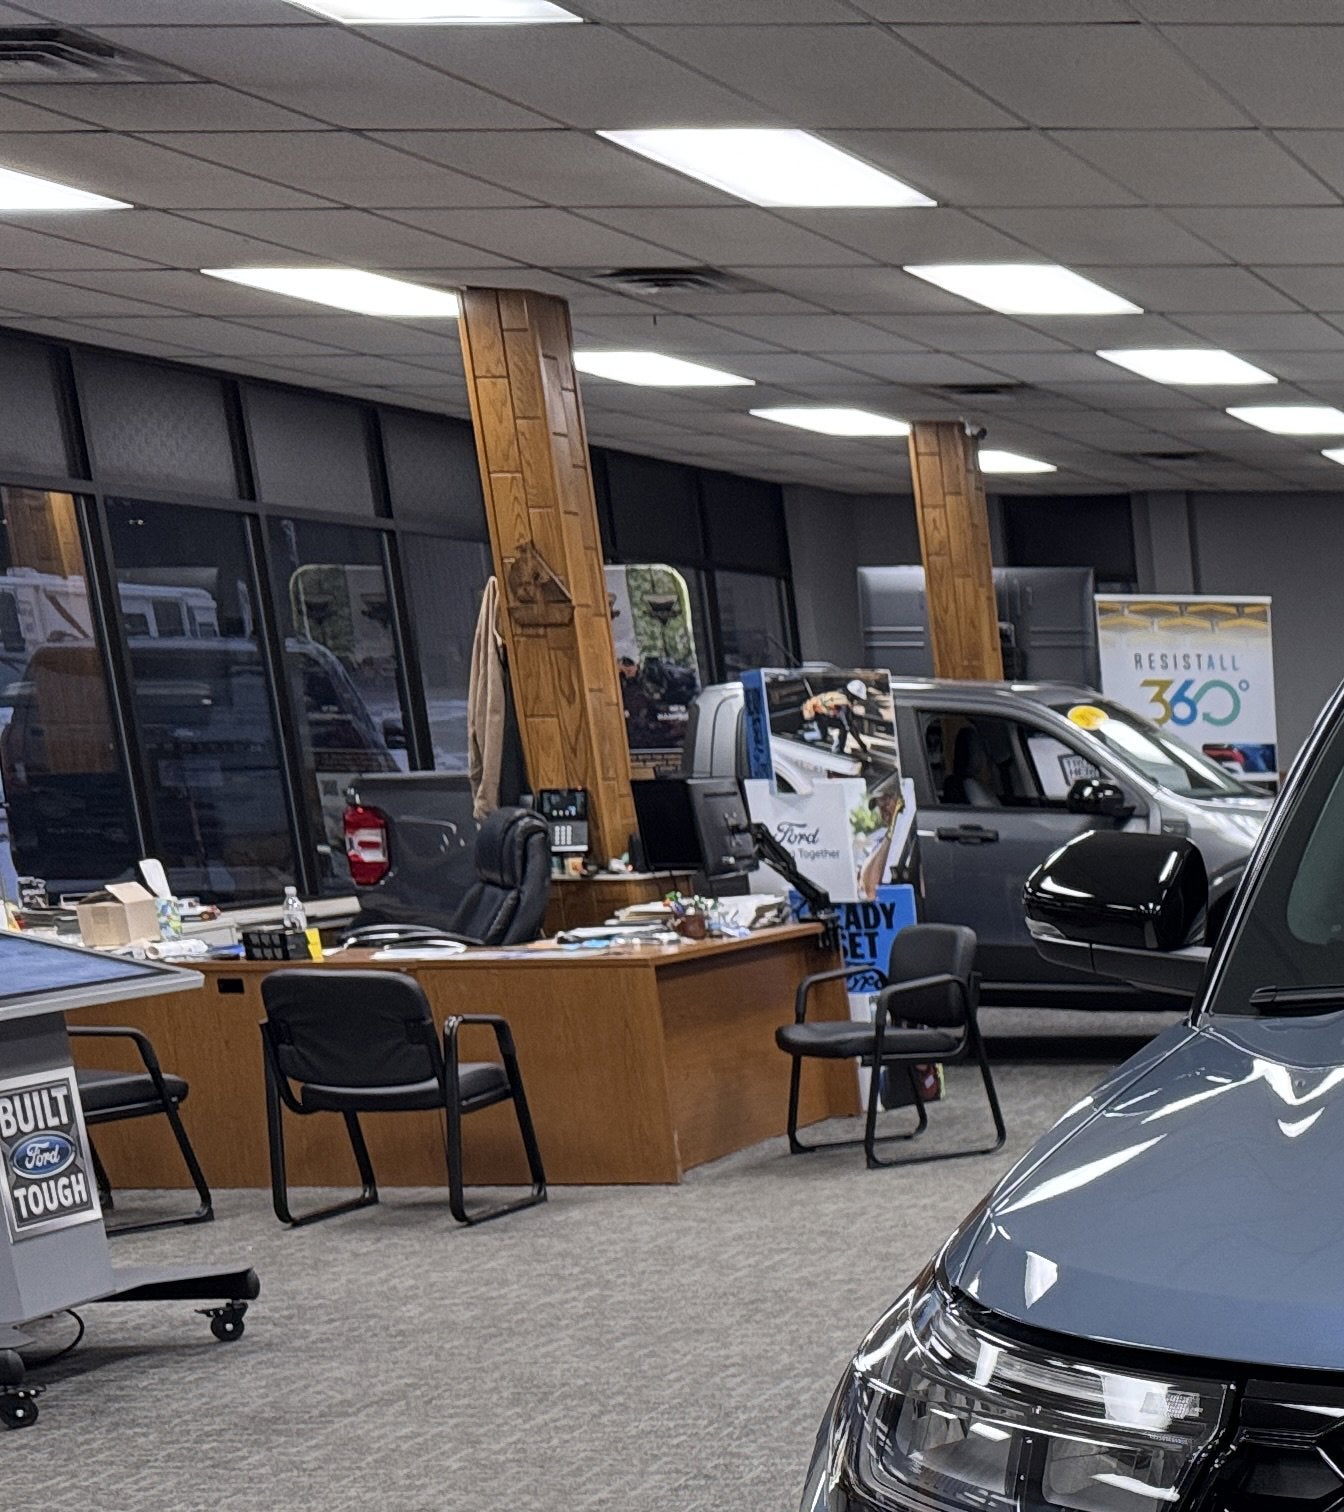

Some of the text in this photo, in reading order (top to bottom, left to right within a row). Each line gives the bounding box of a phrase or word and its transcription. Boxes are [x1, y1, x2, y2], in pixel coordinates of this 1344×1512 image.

[1134, 652, 1240, 672] RESISTALL
[775, 821, 820, 845] Ford
[0, 1086, 69, 1138] BUILT
[24, 1141, 61, 1170] Ford
[13, 1172, 88, 1220] TOUGH
